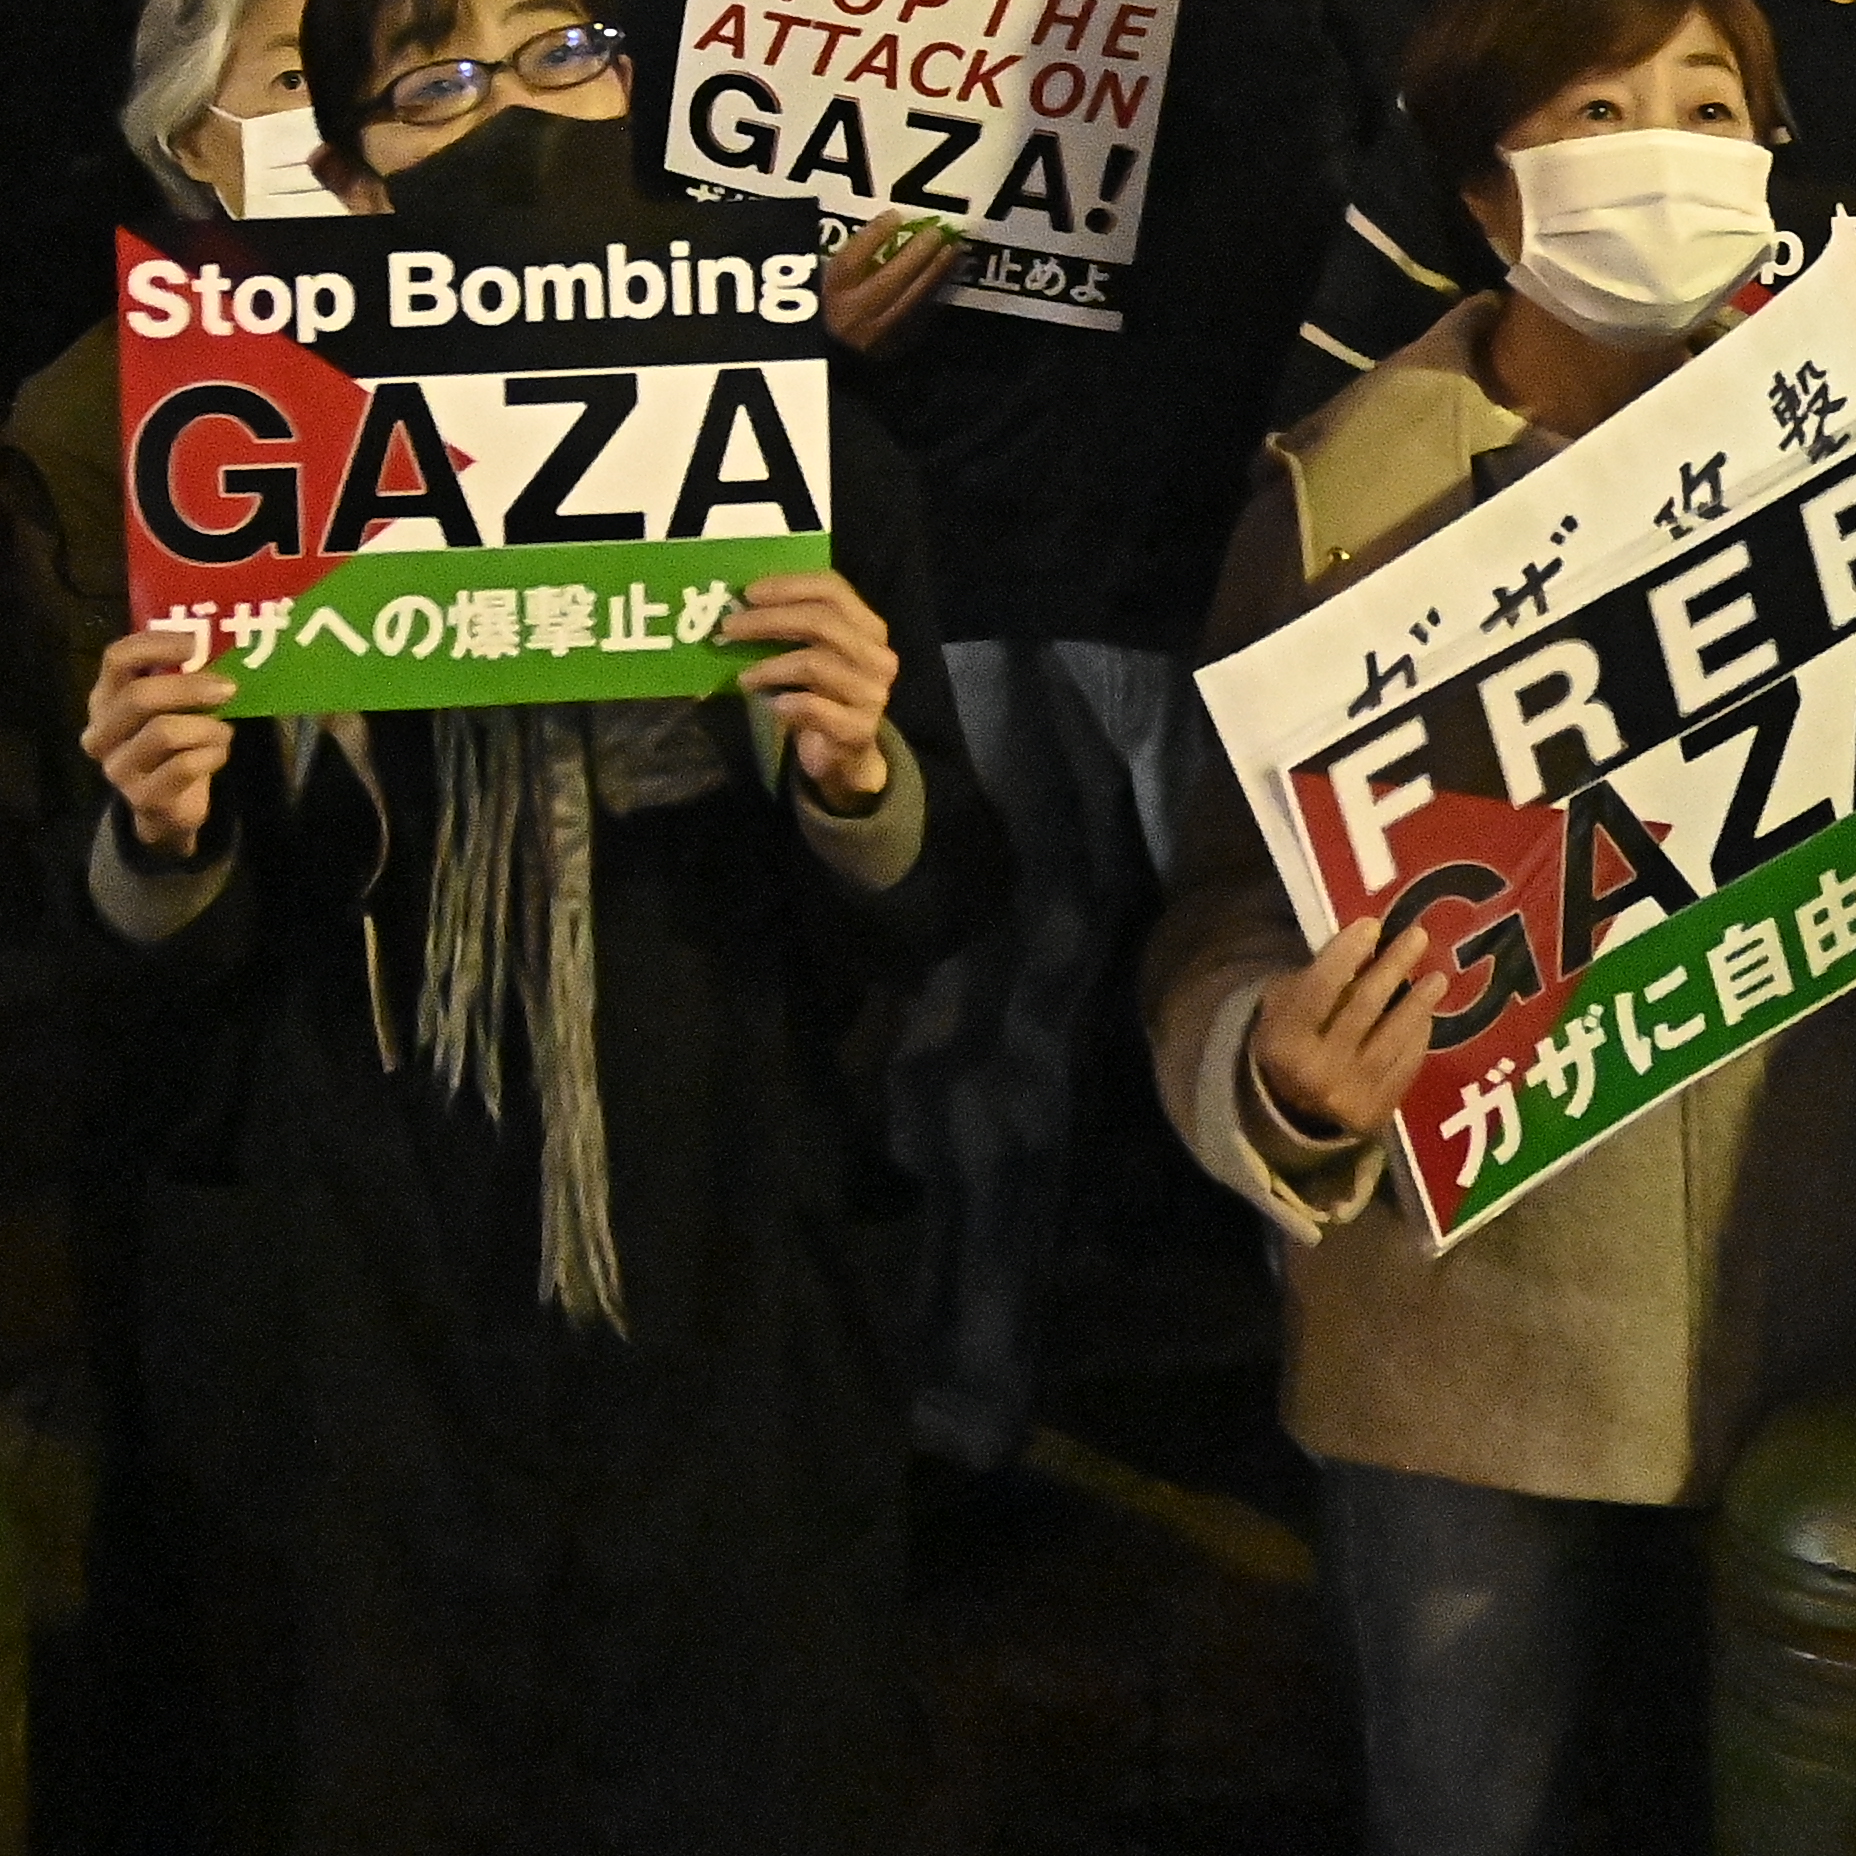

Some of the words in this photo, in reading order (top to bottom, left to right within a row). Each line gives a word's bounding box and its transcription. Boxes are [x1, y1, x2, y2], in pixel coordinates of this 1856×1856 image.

[693, 2, 1024, 110] ATTACK
[1028, 61, 1150, 129] ON
[688, 70, 1142, 236] GAZA!
[125, 259, 357, 344] Stop
[387, 240, 820, 329] Bombing
[130, 366, 826, 568] GAZA
